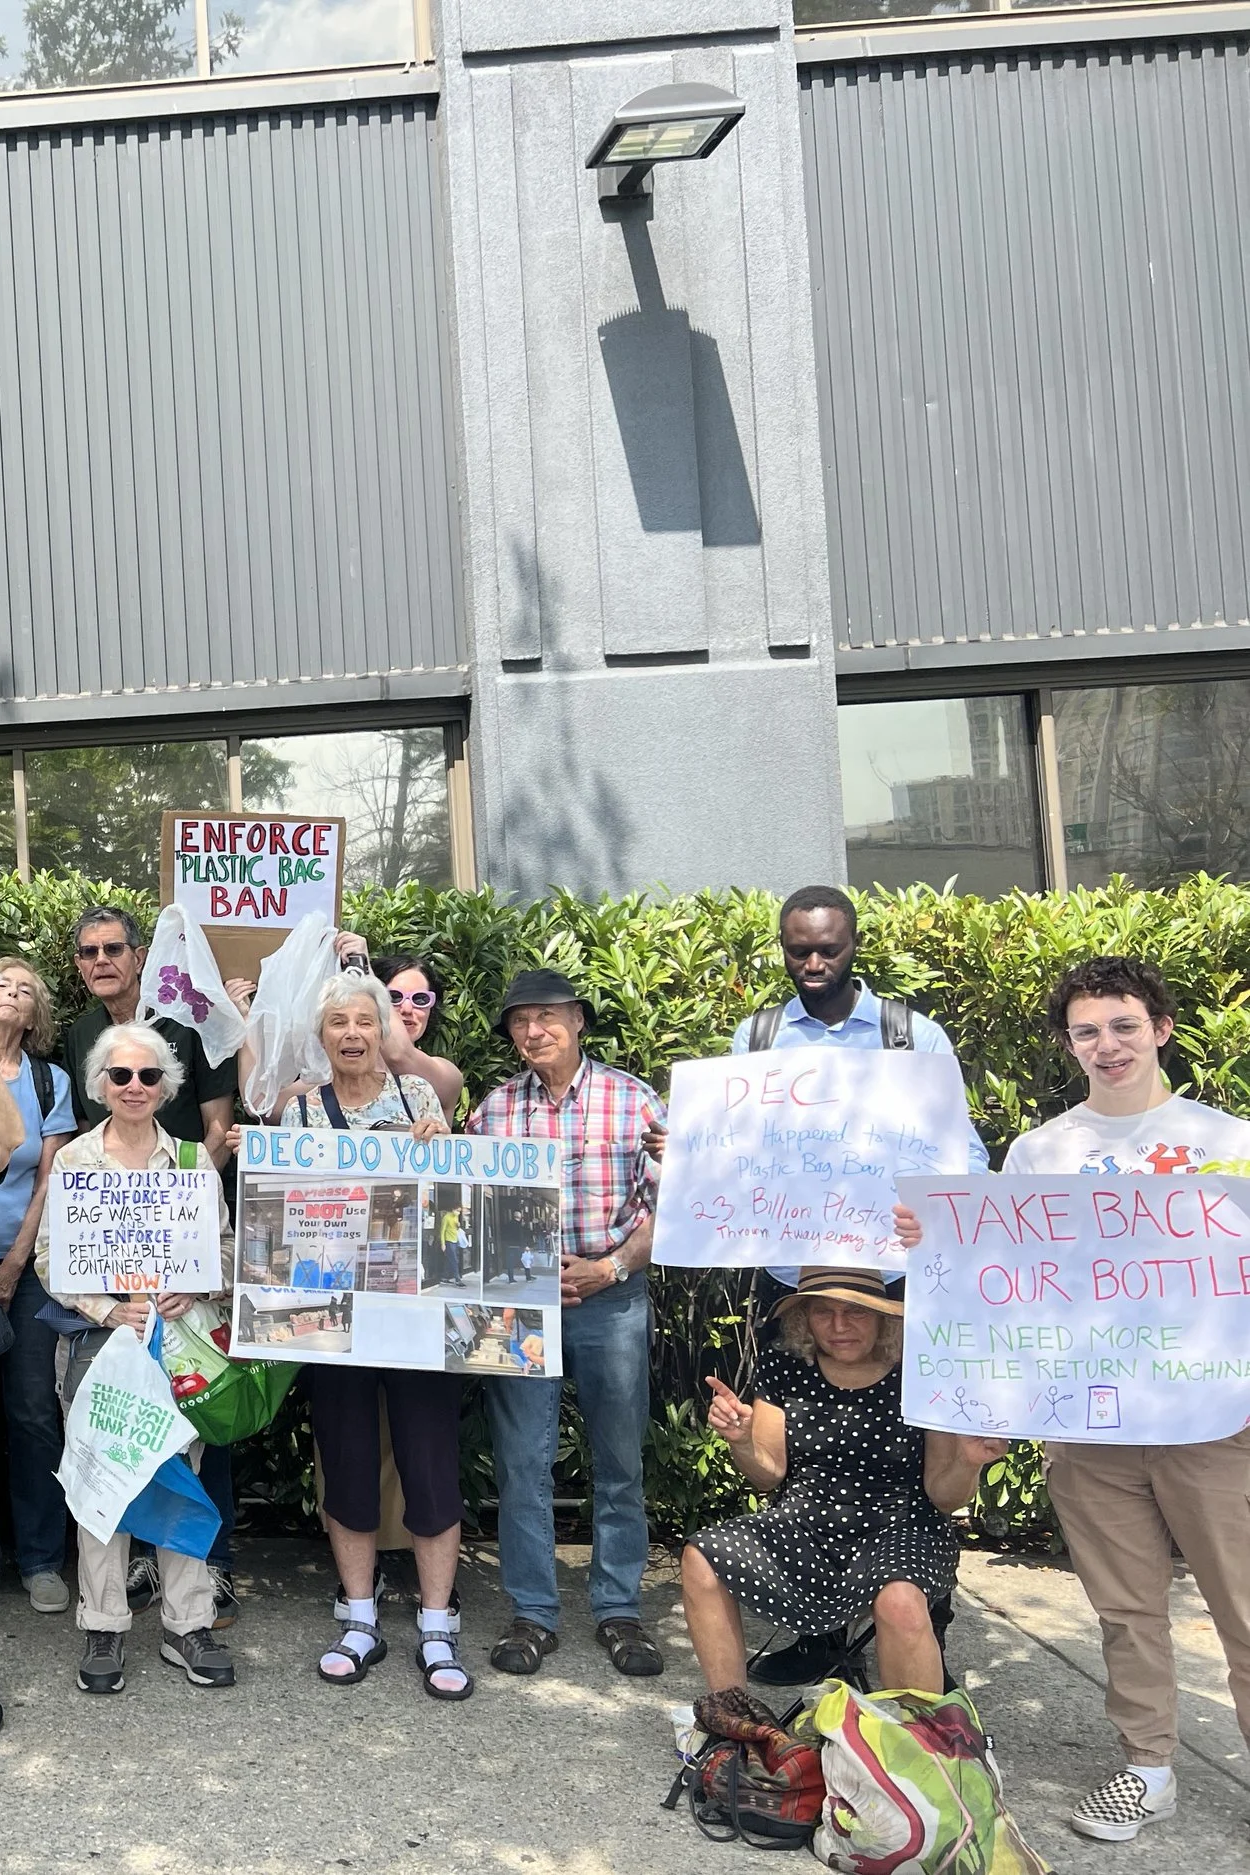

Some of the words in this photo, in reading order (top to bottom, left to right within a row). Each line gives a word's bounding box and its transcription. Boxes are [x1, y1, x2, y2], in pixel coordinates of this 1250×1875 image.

[181, 822, 332, 856] ENFORCE
[181, 854, 267, 887] PLASTIC
[278, 856, 325, 887] BAG
[210, 886, 288, 919] BAN
[724, 1068, 840, 1112] DEC
[246, 1130, 324, 1168] DEC:
[337, 1134, 382, 1171] DO
[391, 1136, 474, 1177] YOUR
[686, 1121, 740, 1153] What
[762, 1120, 853, 1154] Happened
[862, 1123, 885, 1147] to
[886, 1123, 945, 1165] the
[735, 1155, 797, 1179] Plastic
[801, 1152, 833, 1182] Bag
[842, 1151, 886, 1179] Ban
[62, 1172, 99, 1191] DEC
[103, 1172, 122, 1188] DO
[127, 1172, 161, 1188] YOUR
[100, 1189, 171, 1205] ENFORCE
[691, 1195, 736, 1222] 23
[750, 1187, 811, 1223] Billion
[823, 1191, 892, 1227] Plastic
[67, 1206, 103, 1224] BAG
[108, 1205, 162, 1222] WASTE
[170, 1206, 200, 1222] LAW
[118, 1221, 147, 1230] AND
[289, 1207, 304, 1216] Do
[305, 1203, 347, 1220] NOT
[346, 1207, 367, 1216] Use
[298, 1219, 321, 1228] Your
[323, 1219, 348, 1228] Own
[927, 1192, 1077, 1245] TAKE
[1092, 1189, 1242, 1239] BACK
[103, 1229, 173, 1245] ENFORCE
[287, 1230, 335, 1240] Shopping
[336, 1230, 361, 1240] Bags
[778, 1223, 822, 1252] Away
[69, 1244, 172, 1259] RETURNABLE
[68, 1259, 143, 1275] CONTAINER
[979, 1261, 1073, 1306] OUR
[922, 1320, 976, 1347] WE
[989, 1323, 1074, 1353] NEED
[1090, 1325, 1184, 1351] MORE
[917, 1353, 1023, 1380] BOTTLE
[1036, 1358, 1137, 1381] RETURN
[128, 1426, 164, 1453] YOU
